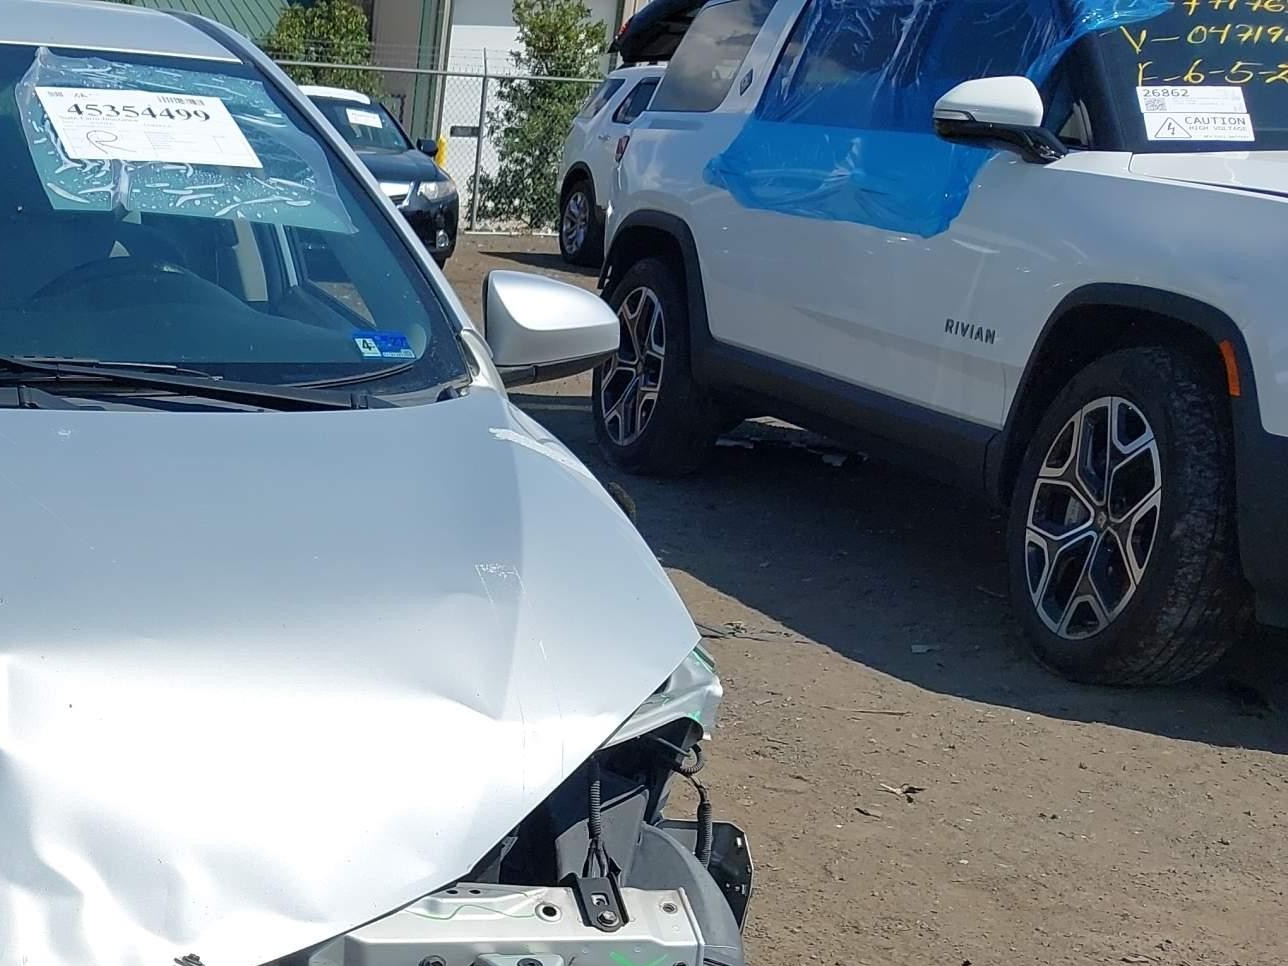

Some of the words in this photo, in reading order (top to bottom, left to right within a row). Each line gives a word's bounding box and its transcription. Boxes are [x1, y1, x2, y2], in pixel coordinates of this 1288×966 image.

[67, 103, 211, 121] 45354499
[1184, 116, 1246, 126] CAUTION
[945, 318, 996, 345] RIVIAN
